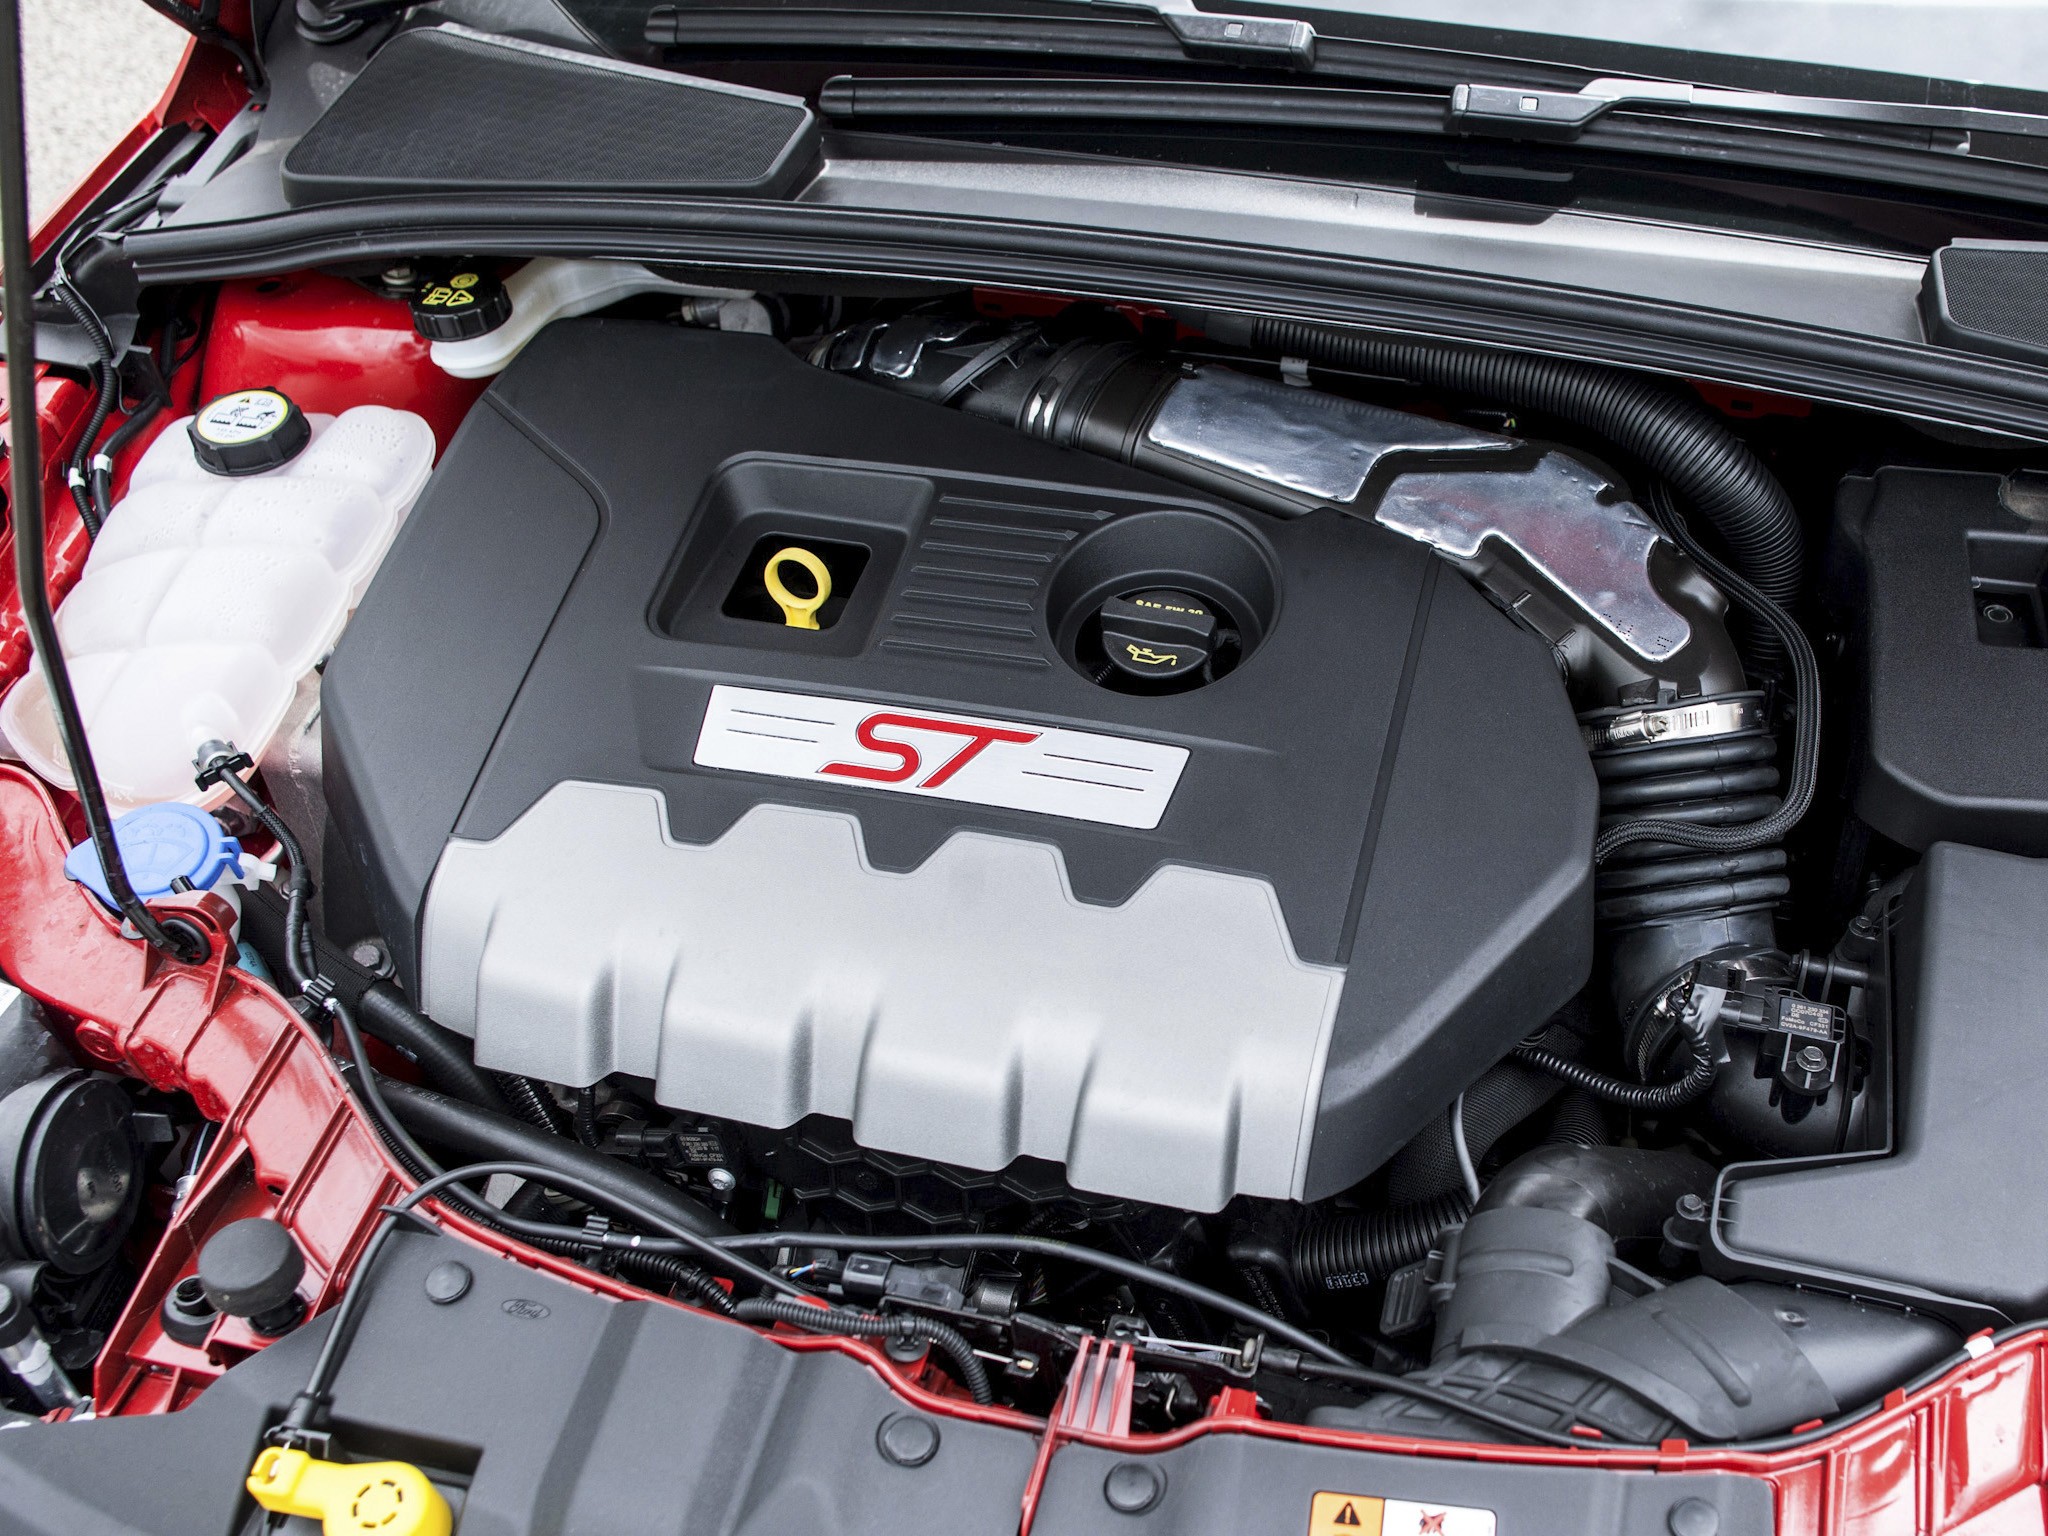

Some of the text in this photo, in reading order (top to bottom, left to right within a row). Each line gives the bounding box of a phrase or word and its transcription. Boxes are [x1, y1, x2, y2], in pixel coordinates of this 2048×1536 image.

[816, 711, 1043, 789] ST
[1781, 1016, 1805, 1024] FoMoCo
[506, 1300, 546, 1318] Ford
